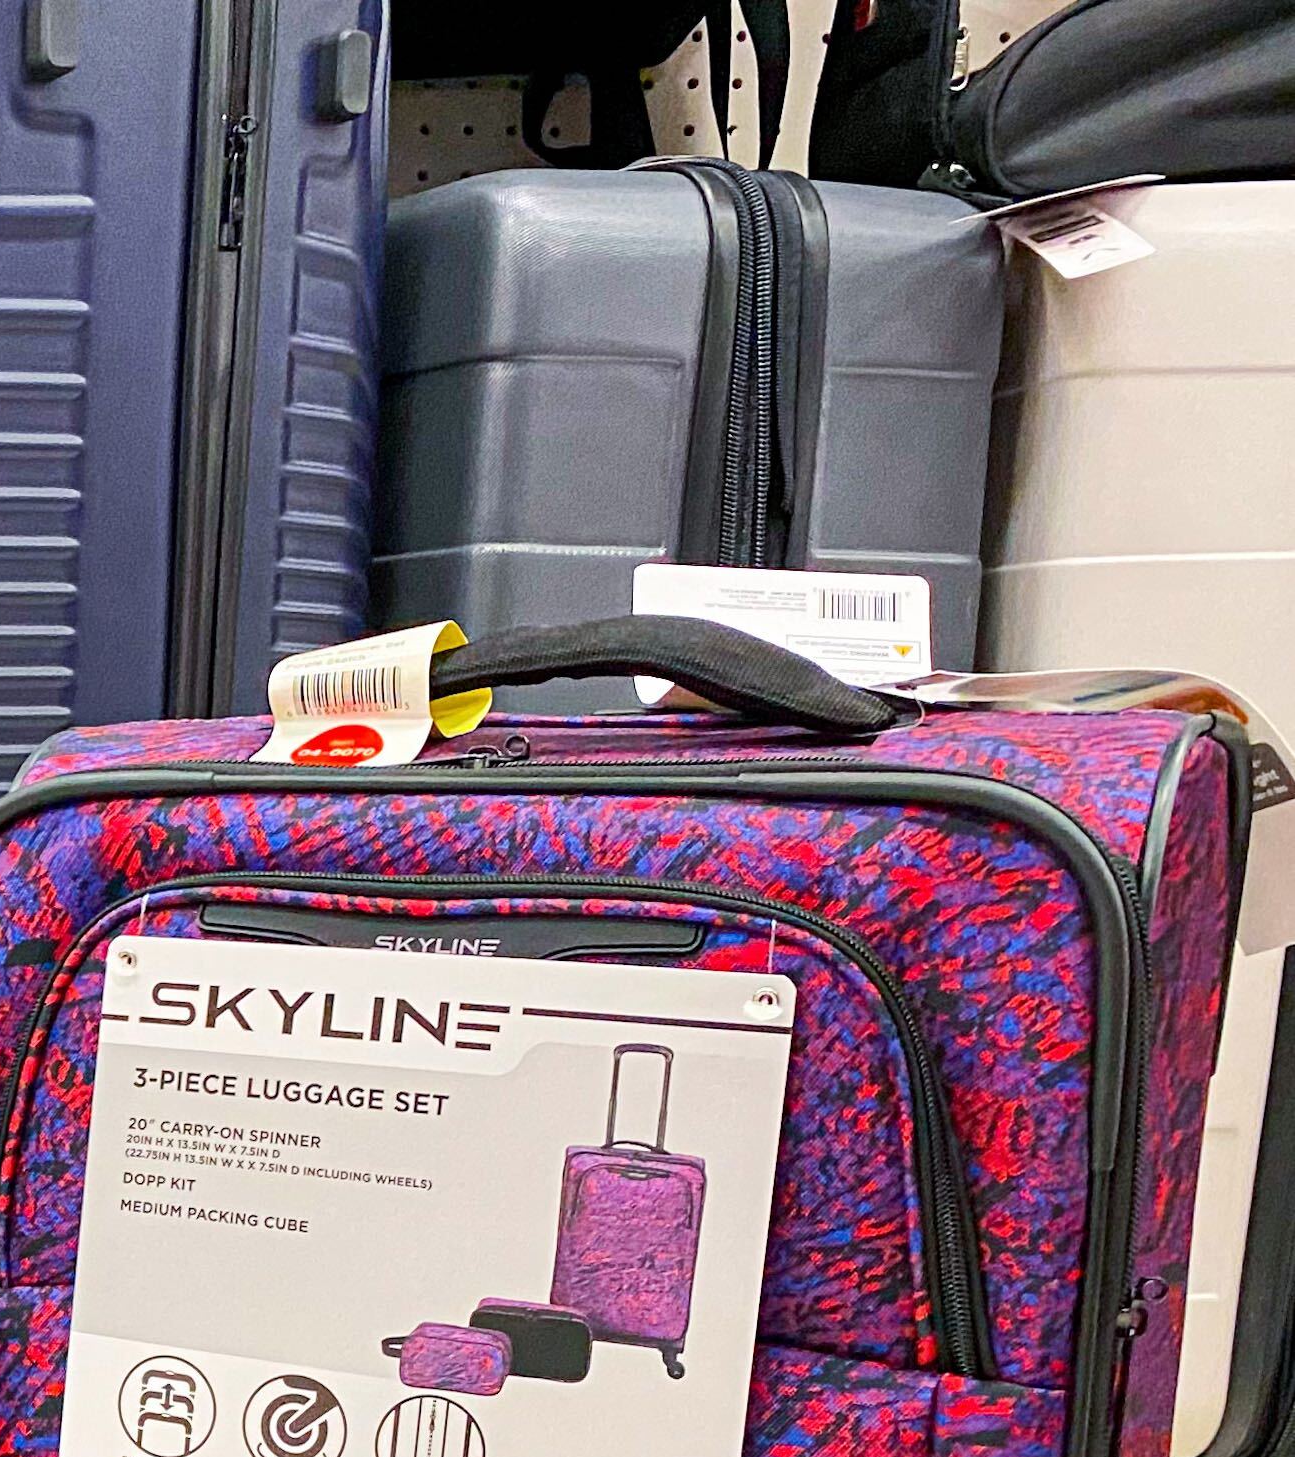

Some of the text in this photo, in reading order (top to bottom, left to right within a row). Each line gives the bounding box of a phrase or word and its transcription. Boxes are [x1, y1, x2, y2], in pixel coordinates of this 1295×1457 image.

[370, 935, 501, 956] SKYLINE
[139, 981, 511, 1051] SKYLINE
[133, 1067, 449, 1116] 3-PIECE LUGGAGE SET
[126, 1134, 280, 1159] 20IN H X 13.5IN W X 7.5IN D
[160, 1120, 244, 1141] CARRY-ON
[249, 1129, 321, 1149] SPINNER
[123, 1172, 196, 1192] DOPP KIT
[125, 1148, 432, 1191] (22.75IN H 13.5IN W X X 7.5IN D INCLUDING WHEELS)
[120, 1199, 309, 1233] MEDIUM PACKING CUBE
